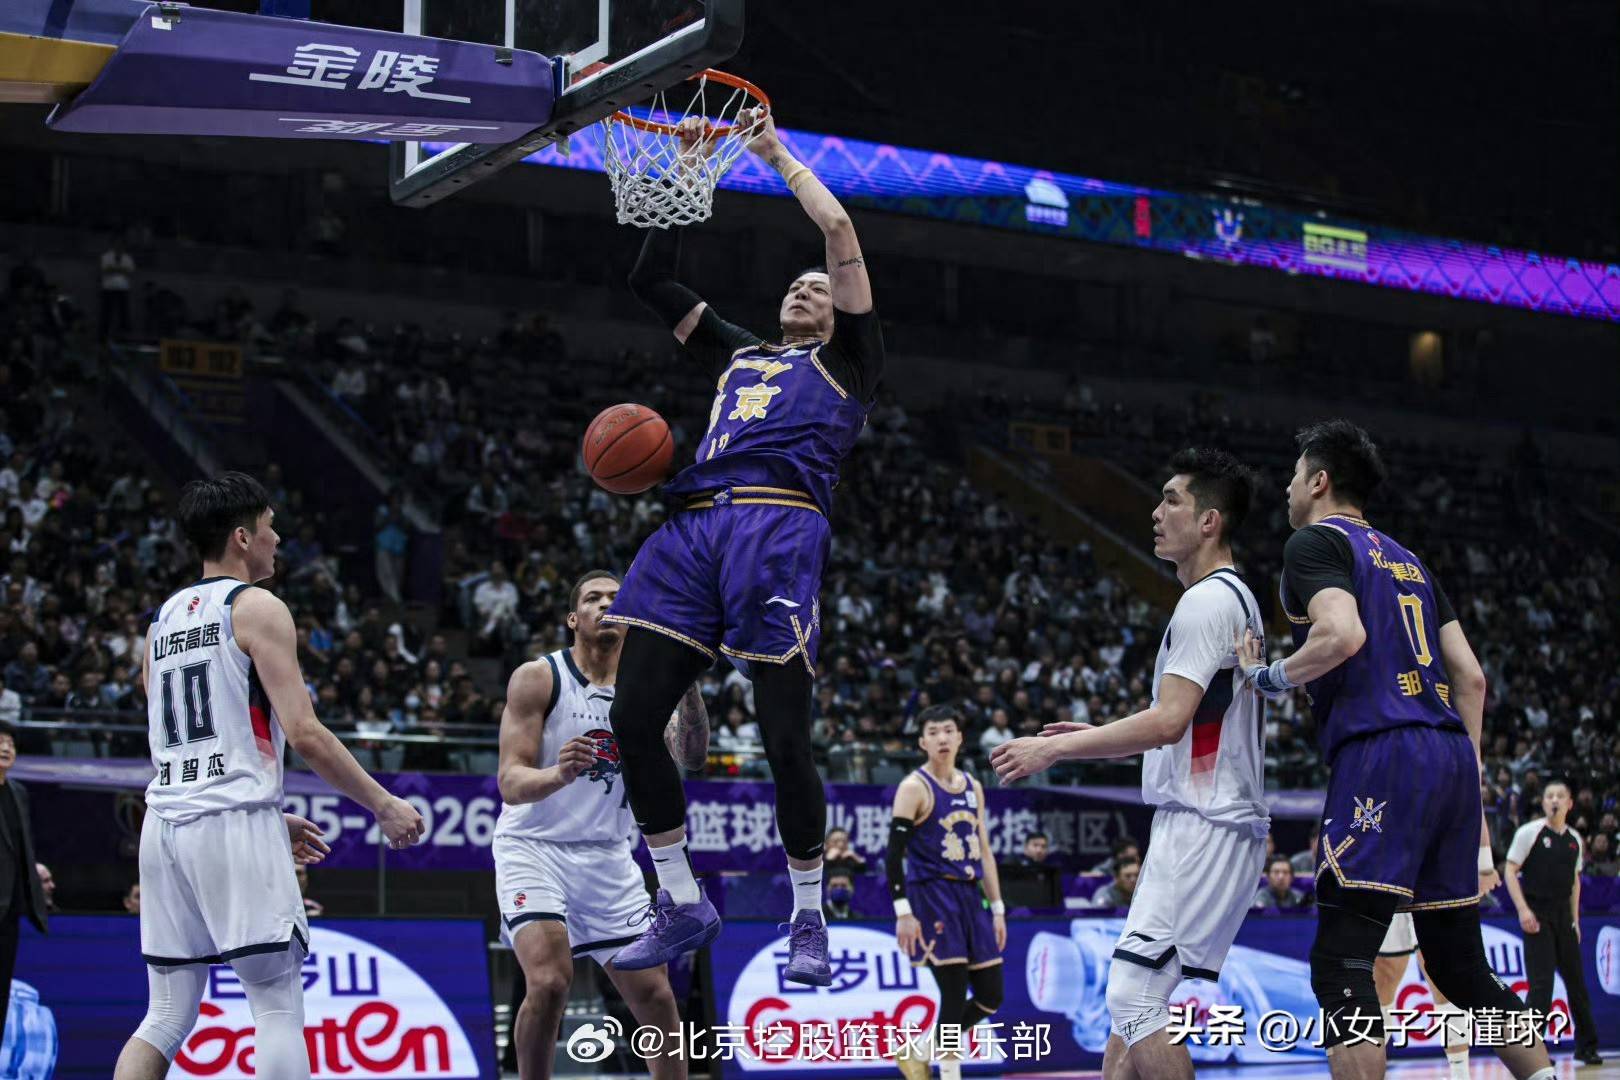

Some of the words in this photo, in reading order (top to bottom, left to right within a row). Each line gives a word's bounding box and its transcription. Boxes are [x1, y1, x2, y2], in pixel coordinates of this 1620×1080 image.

[249, 43, 471, 104] 金陵
[1368, 548, 1426, 585] 北集团
[154, 622, 220, 661] 山东高速
[1397, 592, 1433, 668] 0
[160, 659, 218, 748] 10
